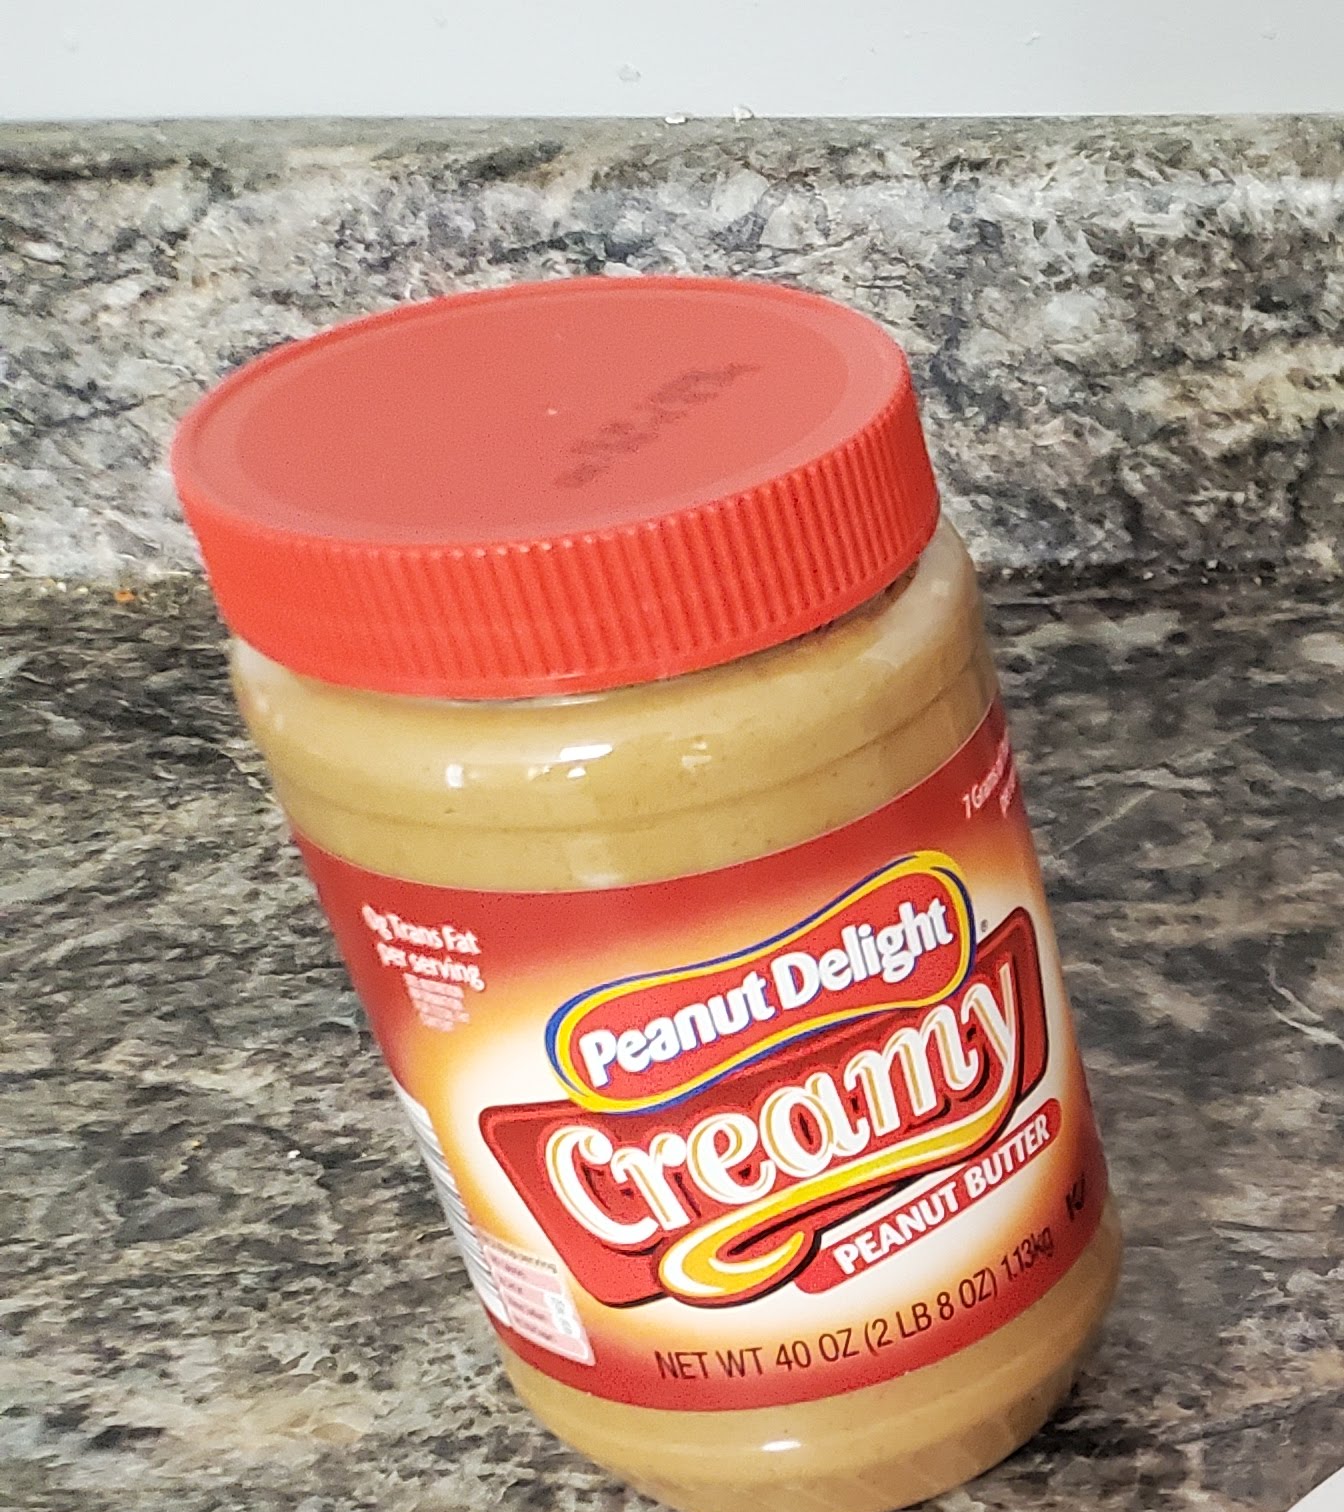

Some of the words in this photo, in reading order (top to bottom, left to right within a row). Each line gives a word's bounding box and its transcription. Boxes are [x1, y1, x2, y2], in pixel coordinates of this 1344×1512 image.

[408, 952, 486, 991] serving
[441, 924, 482, 955] Fat
[577, 971, 775, 1088] Peanut
[769, 897, 954, 1010] Delight
[545, 961, 1014, 1260] Creamy
[833, 1181, 960, 1275] PEANUT
[963, 1114, 1050, 1200] BUTTER
[654, 1350, 709, 1380] NET
[716, 1347, 764, 1379] WT
[775, 1340, 812, 1372] 40
[818, 1328, 860, 1363] OZ
[864, 1319, 894, 1356] (2
[899, 1301, 933, 1338] LB
[938, 1292, 955, 1321] 8
[958, 1266, 999, 1309] OZ)
[1001, 1227, 1055, 1282] 1.13kg
